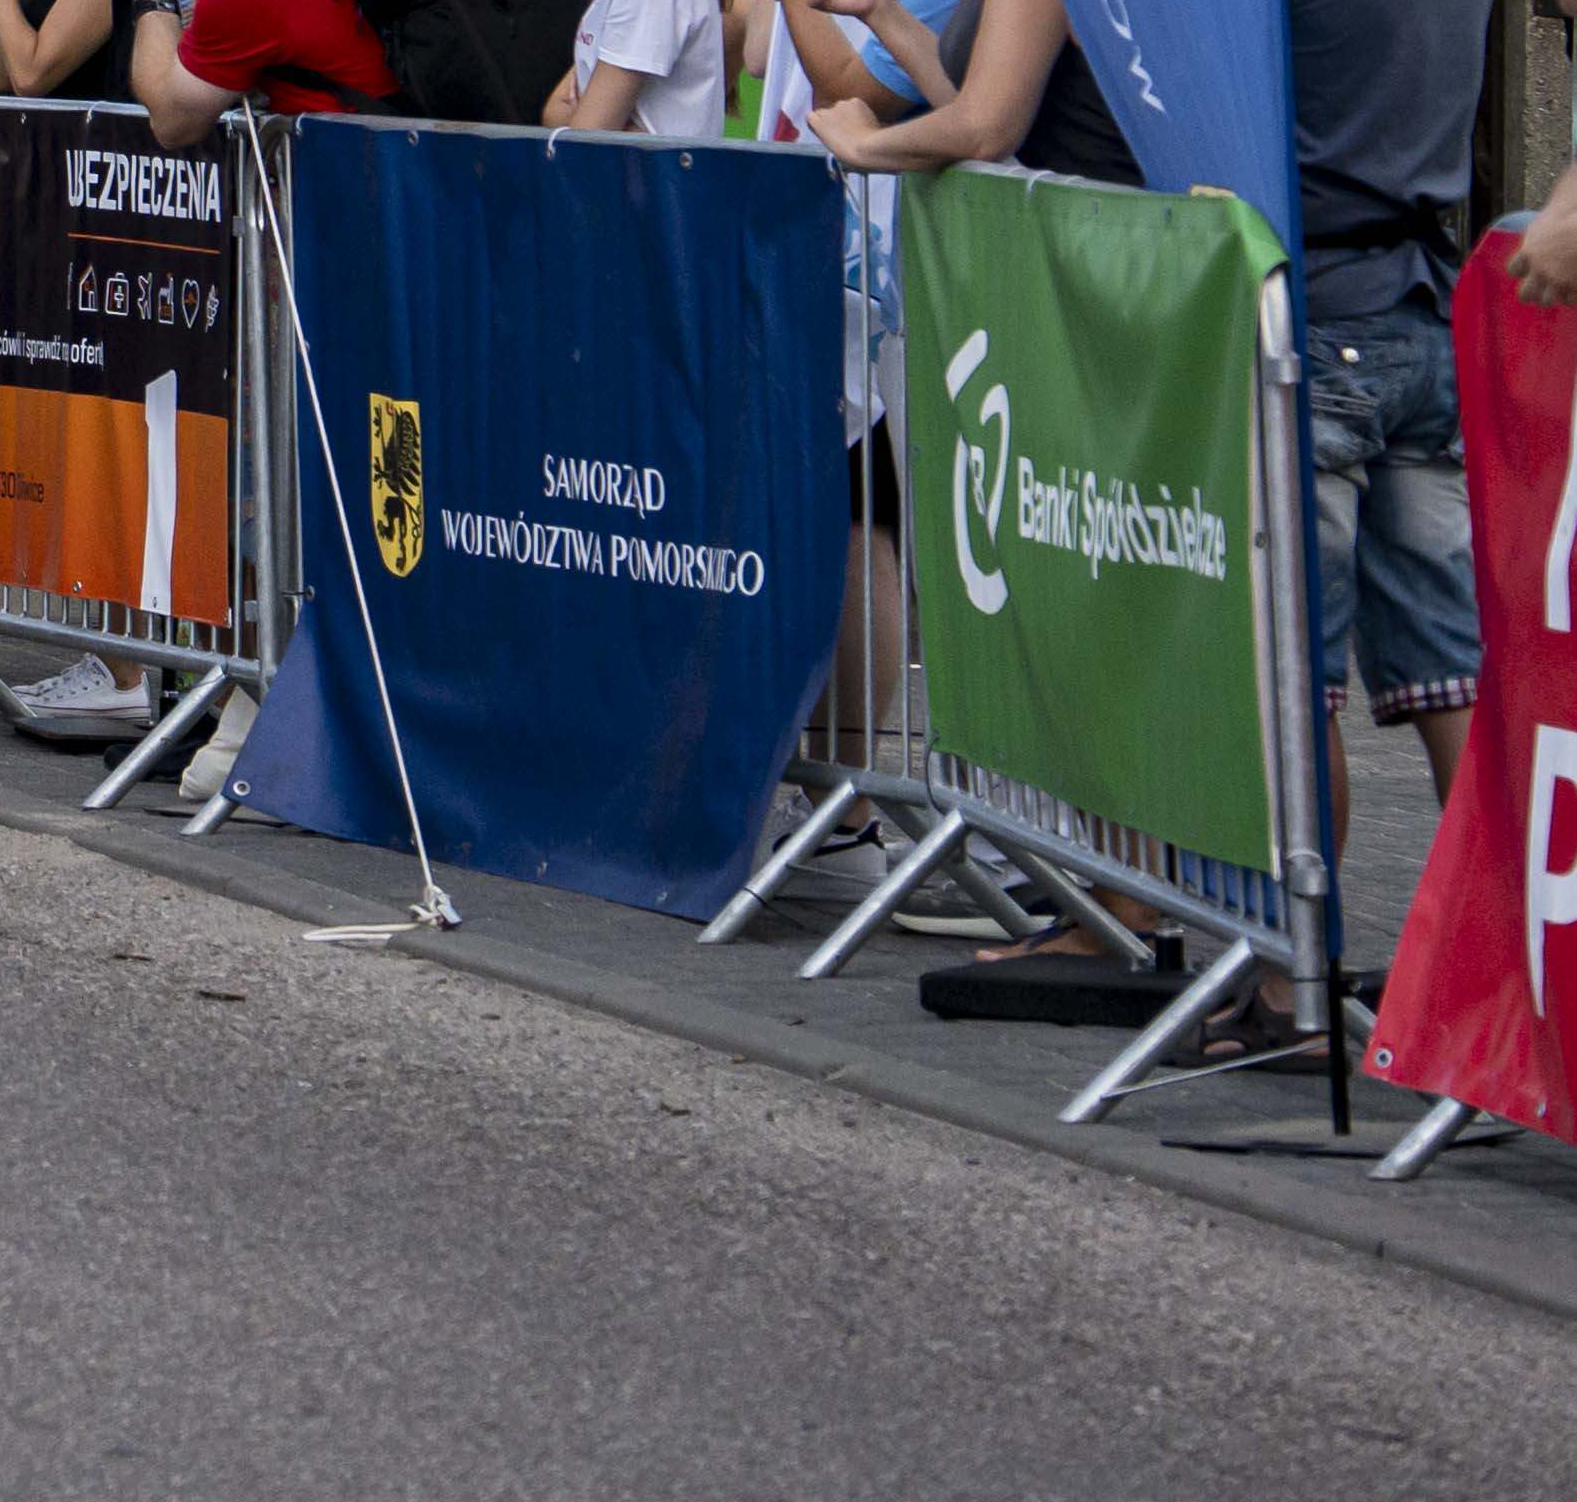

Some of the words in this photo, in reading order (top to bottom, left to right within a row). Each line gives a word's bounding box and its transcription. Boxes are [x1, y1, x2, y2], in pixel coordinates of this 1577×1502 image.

[543, 453, 666, 520] SAMORZĄD
[1017, 455, 1080, 551] Banki
[441, 508, 605, 575] WOJEWÓDZTWA
[611, 533, 765, 597] POMORSKIEGO
